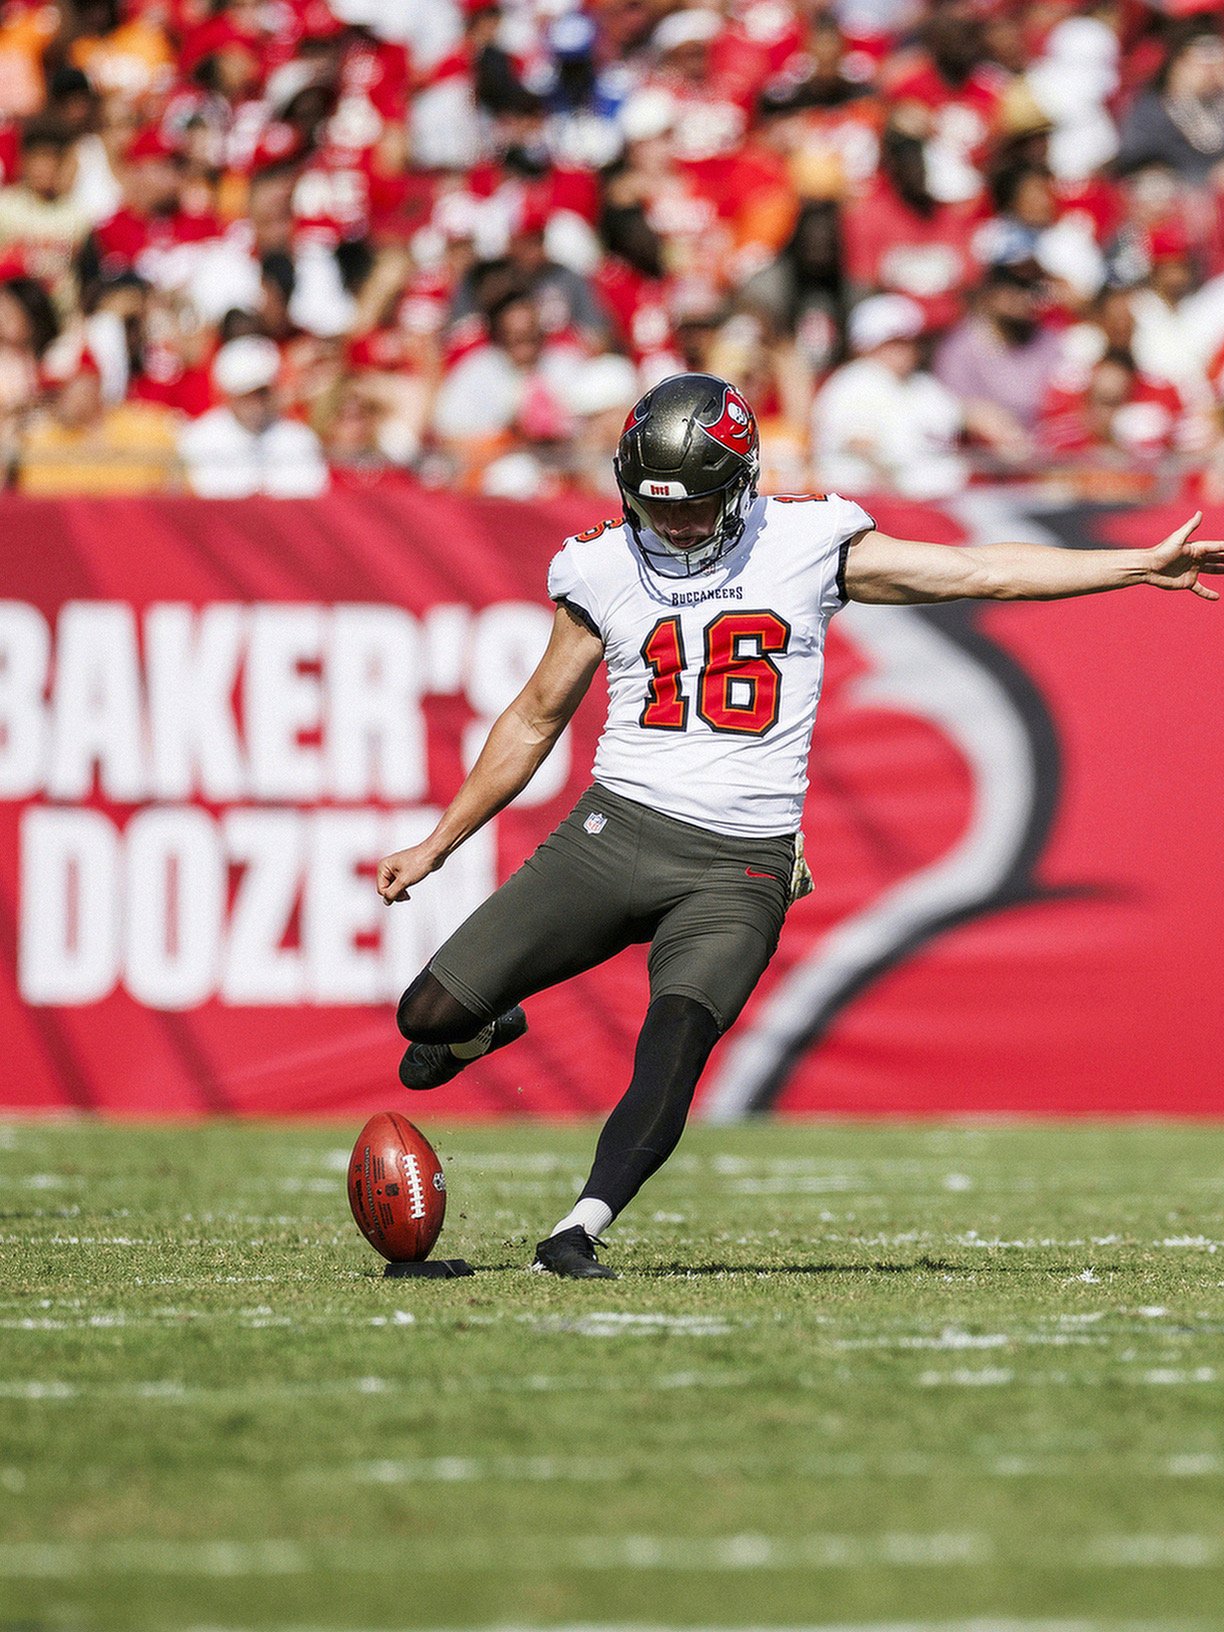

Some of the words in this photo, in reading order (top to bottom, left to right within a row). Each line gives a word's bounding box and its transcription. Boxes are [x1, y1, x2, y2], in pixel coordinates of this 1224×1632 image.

[671, 586, 743, 606] BUCCANEERS
[0, 600, 572, 807] BAKER'S
[639, 609, 790, 737] 16
